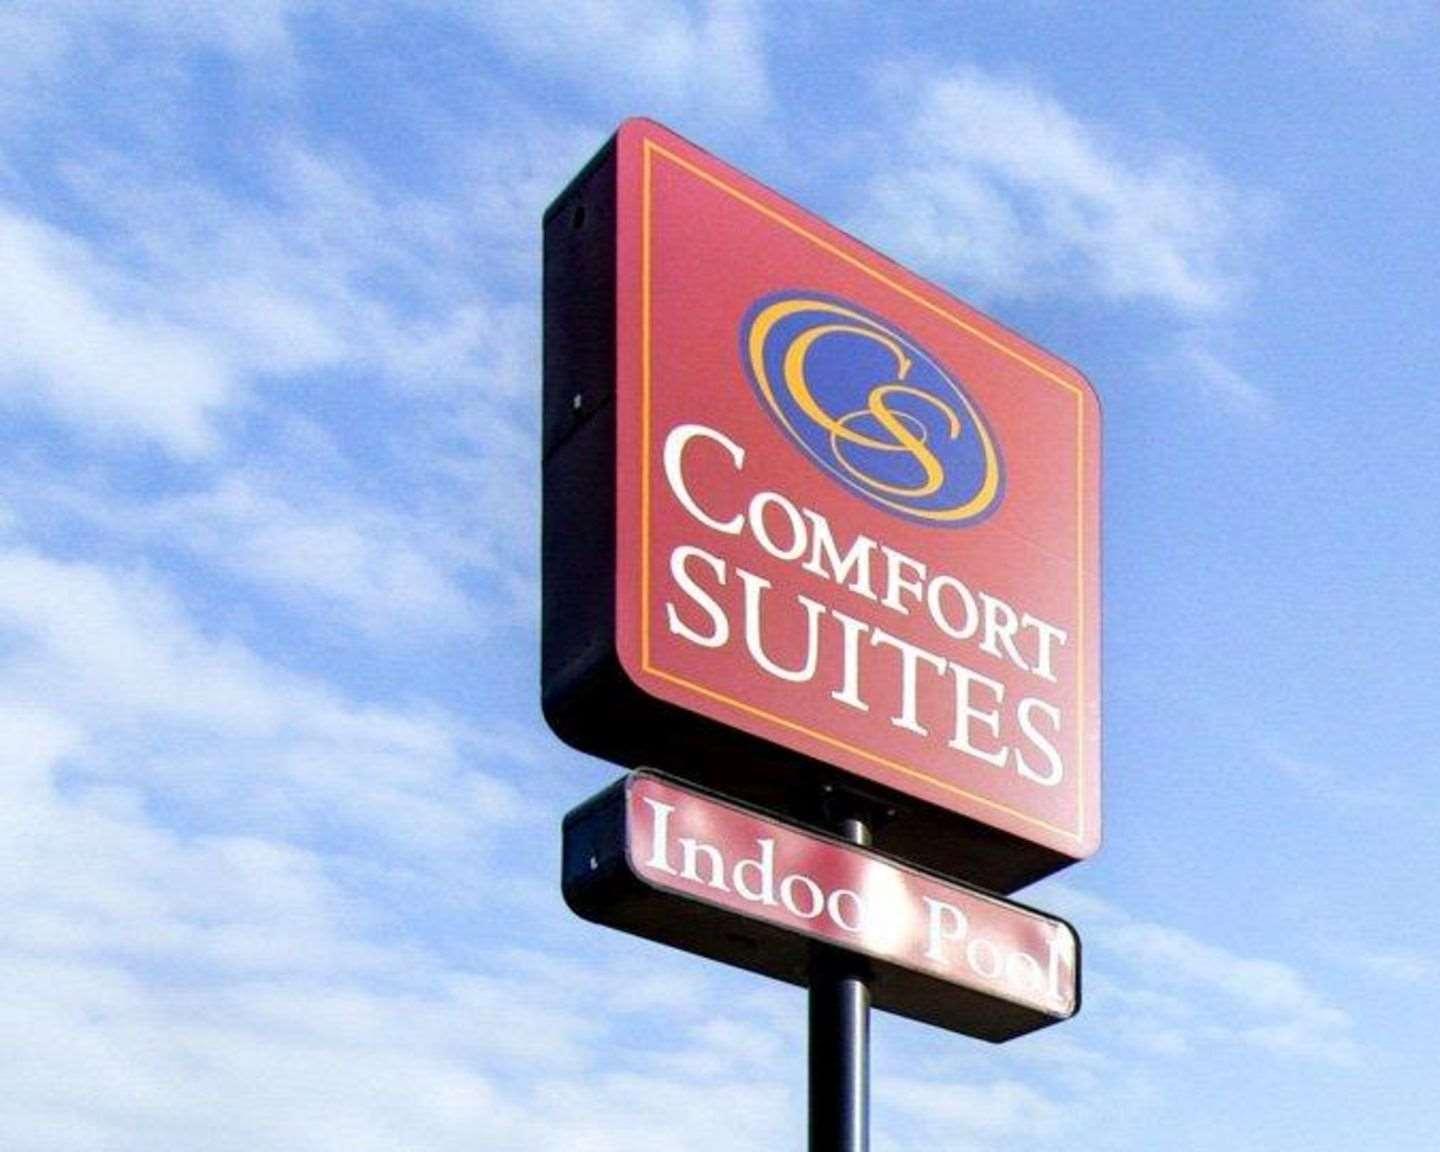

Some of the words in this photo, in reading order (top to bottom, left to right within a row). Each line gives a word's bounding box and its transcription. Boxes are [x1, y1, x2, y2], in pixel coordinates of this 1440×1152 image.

[662, 423, 1068, 682] COMFORT
[665, 544, 1064, 787] SUITES
[643, 796, 878, 934] Indoo
